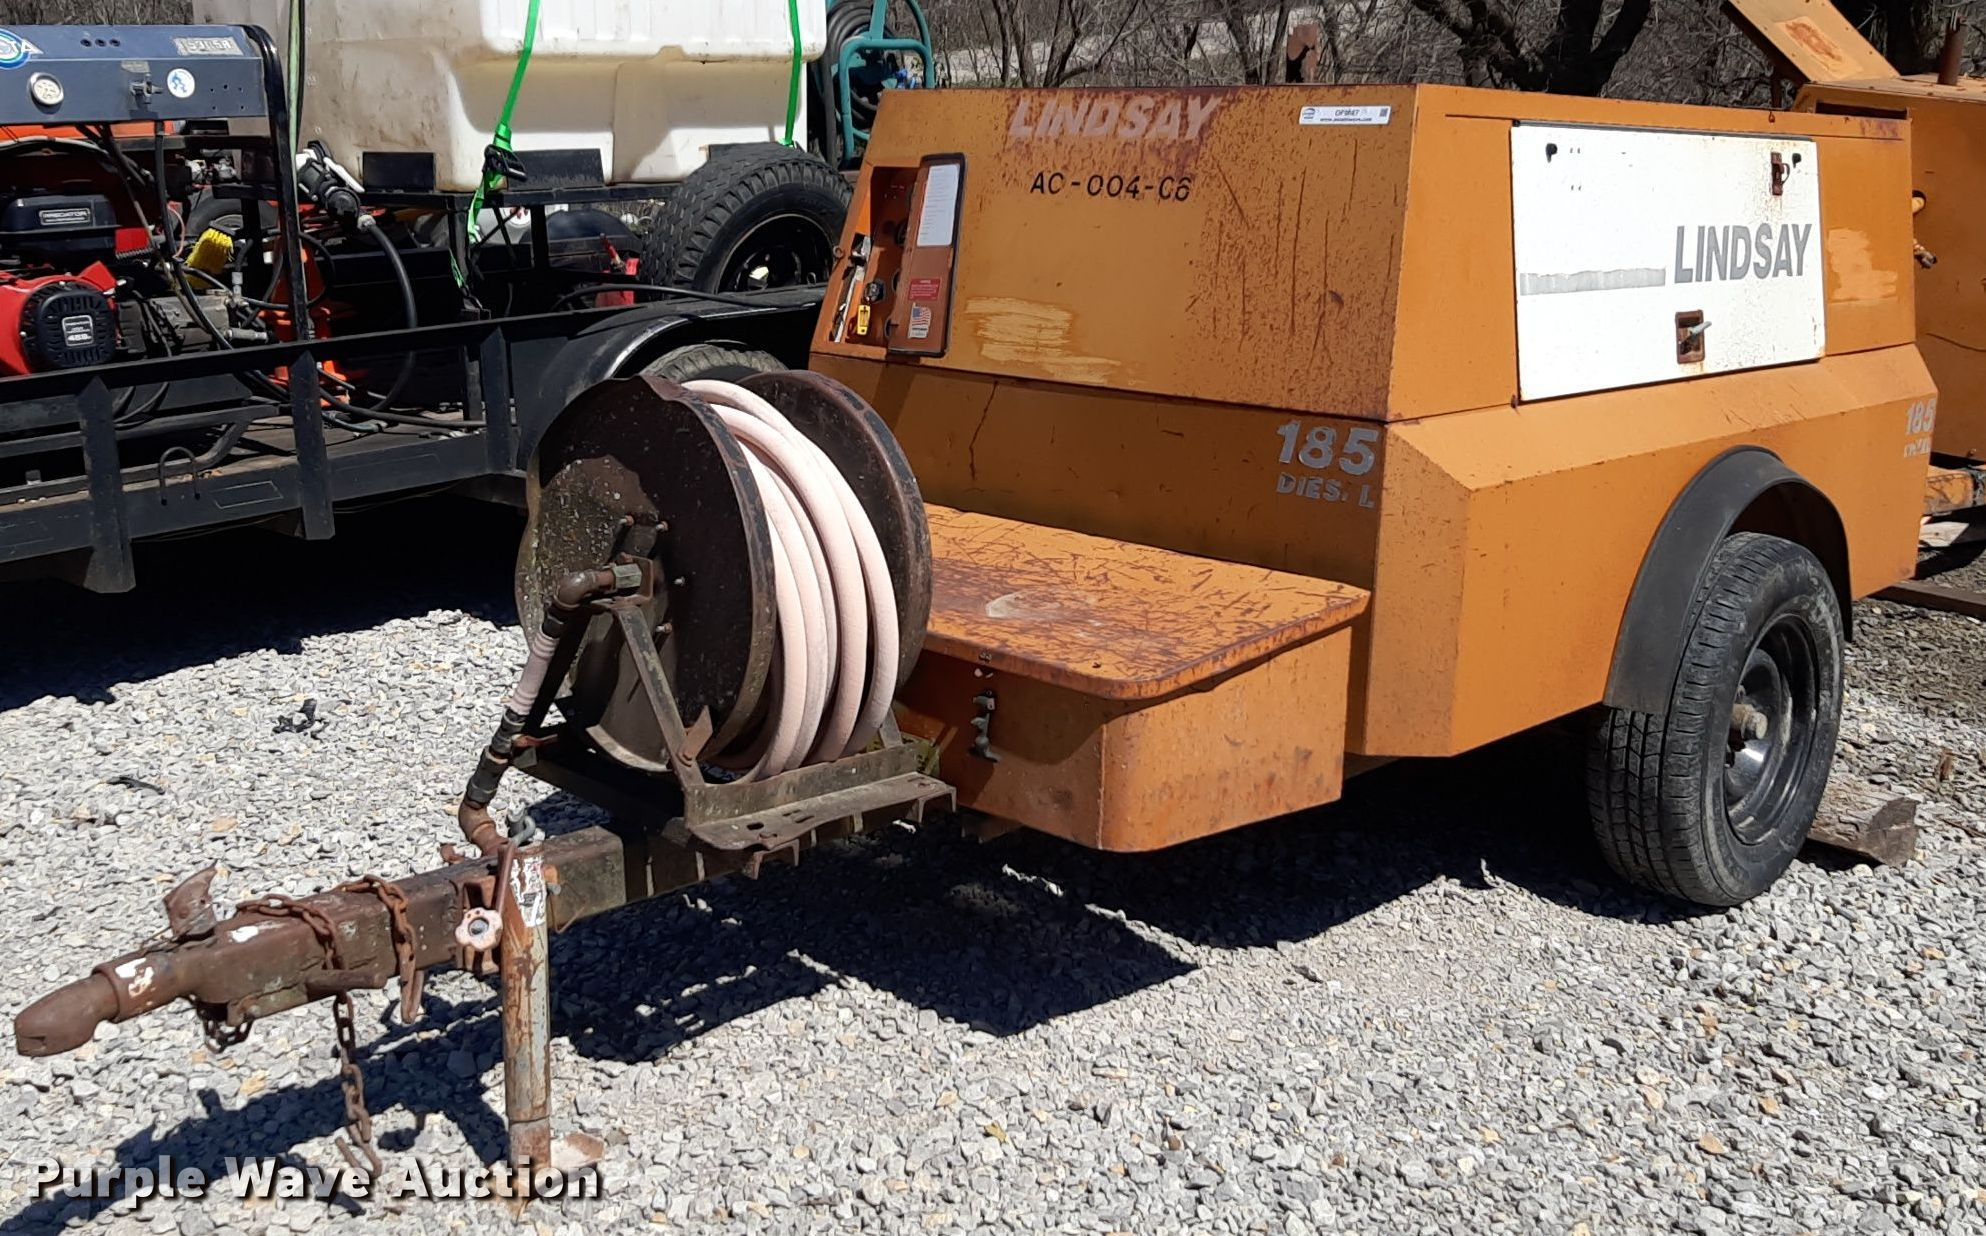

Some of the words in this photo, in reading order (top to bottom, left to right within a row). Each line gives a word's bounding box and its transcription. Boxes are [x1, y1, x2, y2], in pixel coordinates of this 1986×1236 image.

[1008, 95, 1222, 140] LINDSAY
[1674, 223, 1812, 283] LINDSAY
[1906, 398, 1937, 436] 185
[1277, 420, 1379, 475] 185
[1276, 472, 1375, 508] DIESL
